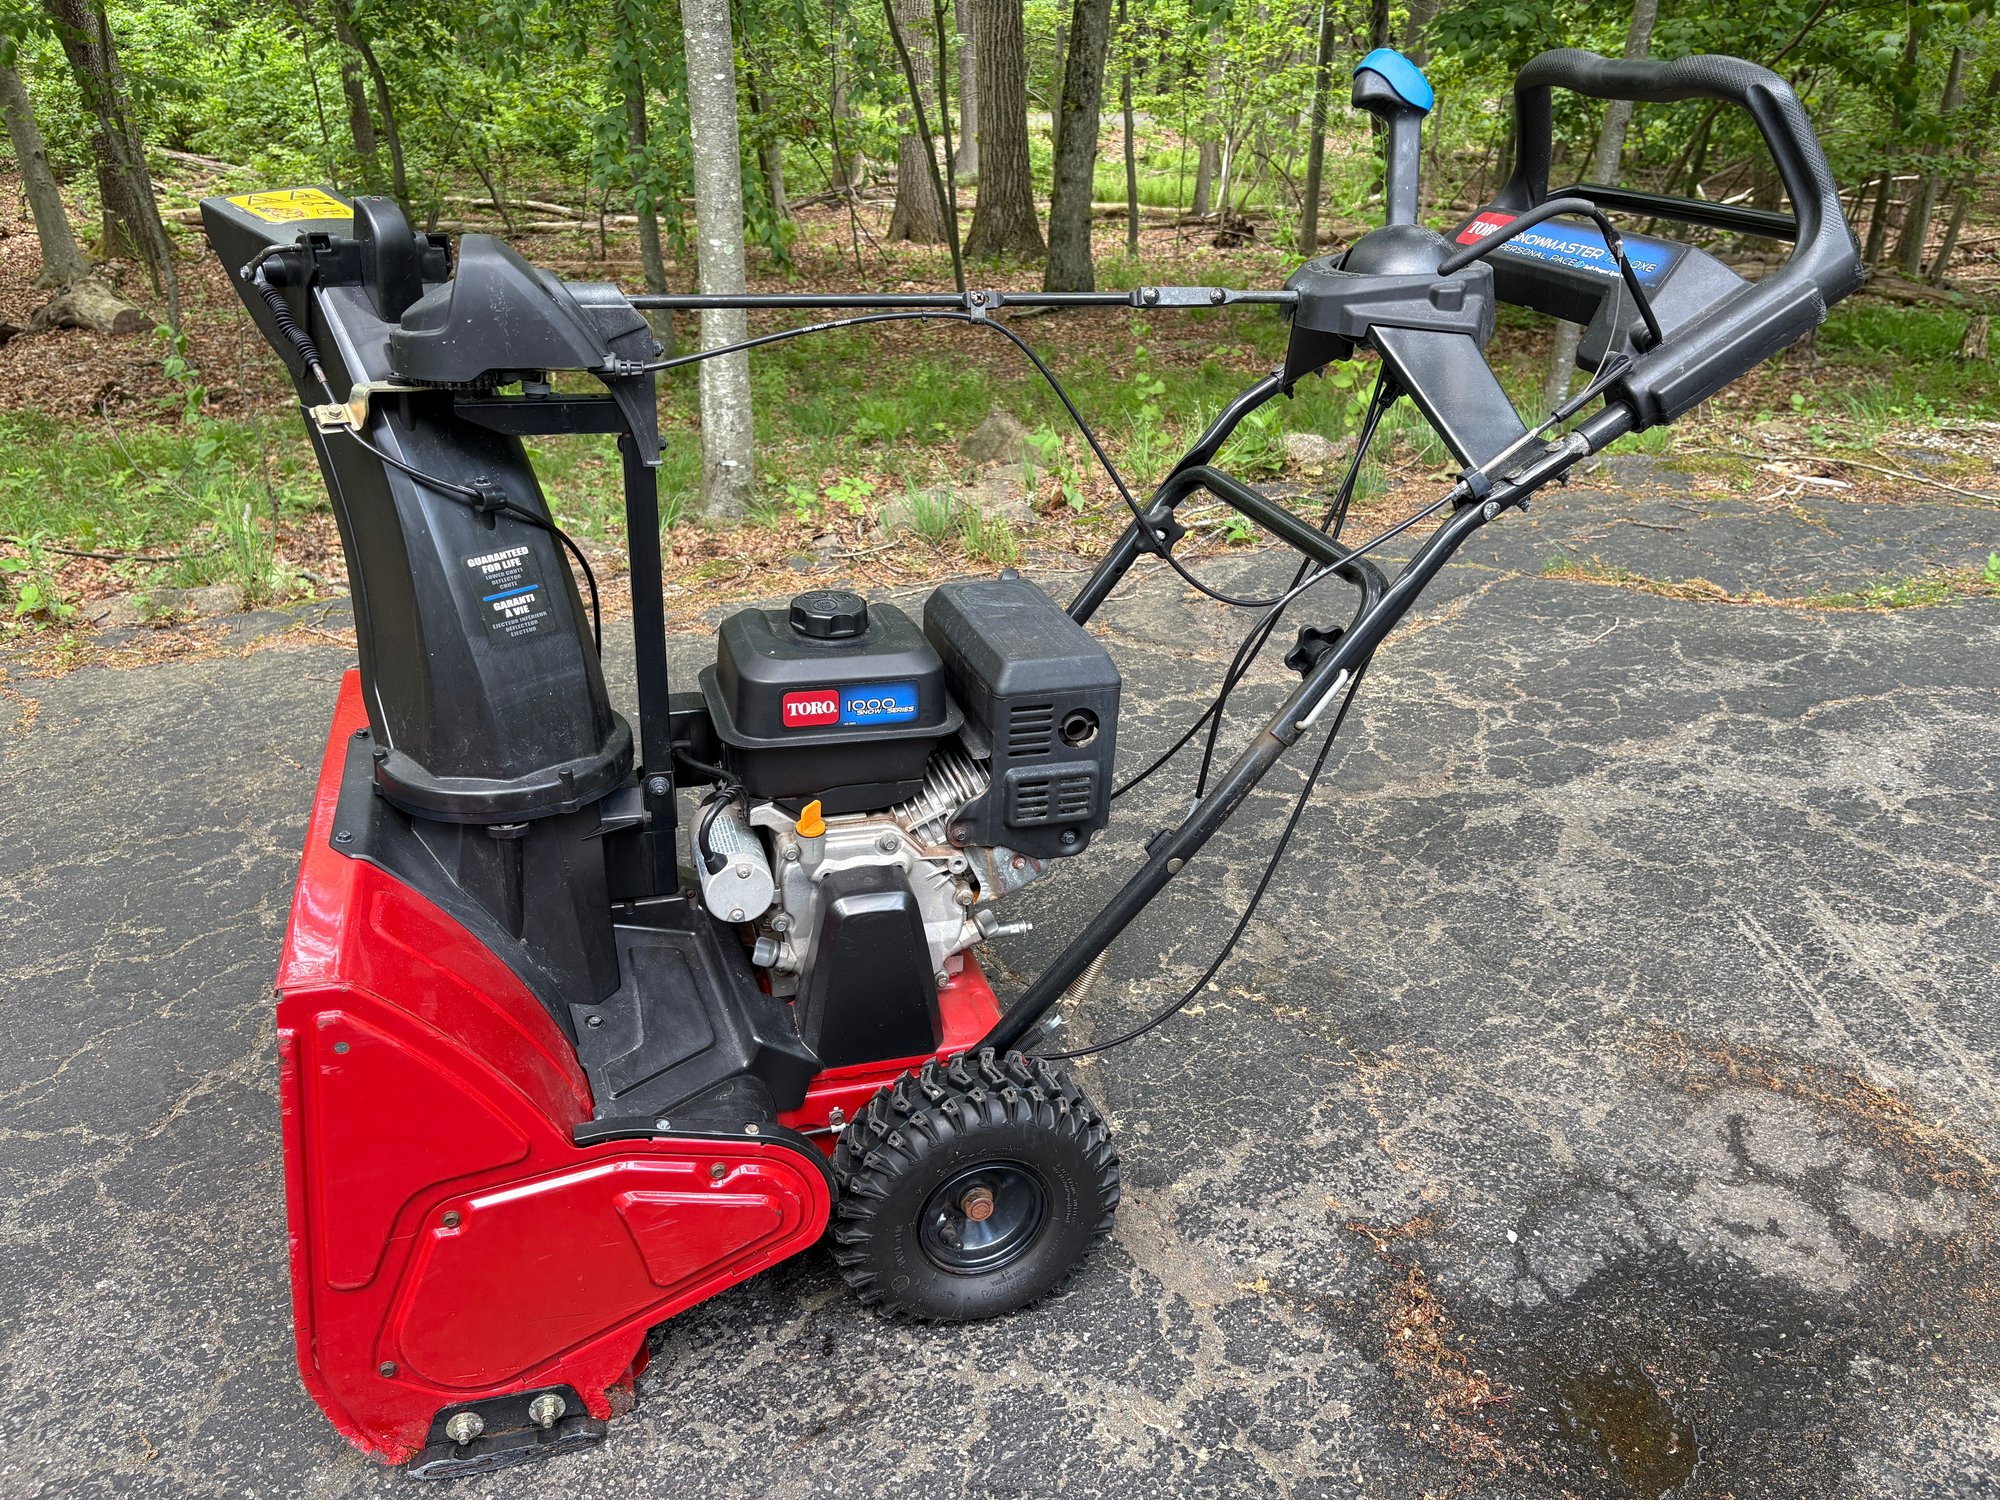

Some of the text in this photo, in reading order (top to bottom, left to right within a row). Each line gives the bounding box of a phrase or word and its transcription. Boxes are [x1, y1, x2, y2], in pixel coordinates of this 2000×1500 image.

[1467, 221, 1503, 237] TOR
[1497, 243, 1577, 266] PERSONAL PACE
[1630, 260, 1657, 273] QXE
[467, 546, 529, 568] GUARANTEED
[481, 557, 522, 574] FOR LIFE
[493, 593, 536, 611] GARANTI
[513, 604, 530, 616] VIE
[847, 697, 896, 712] 1000
[856, 705, 915, 716] SNOW SERIES
